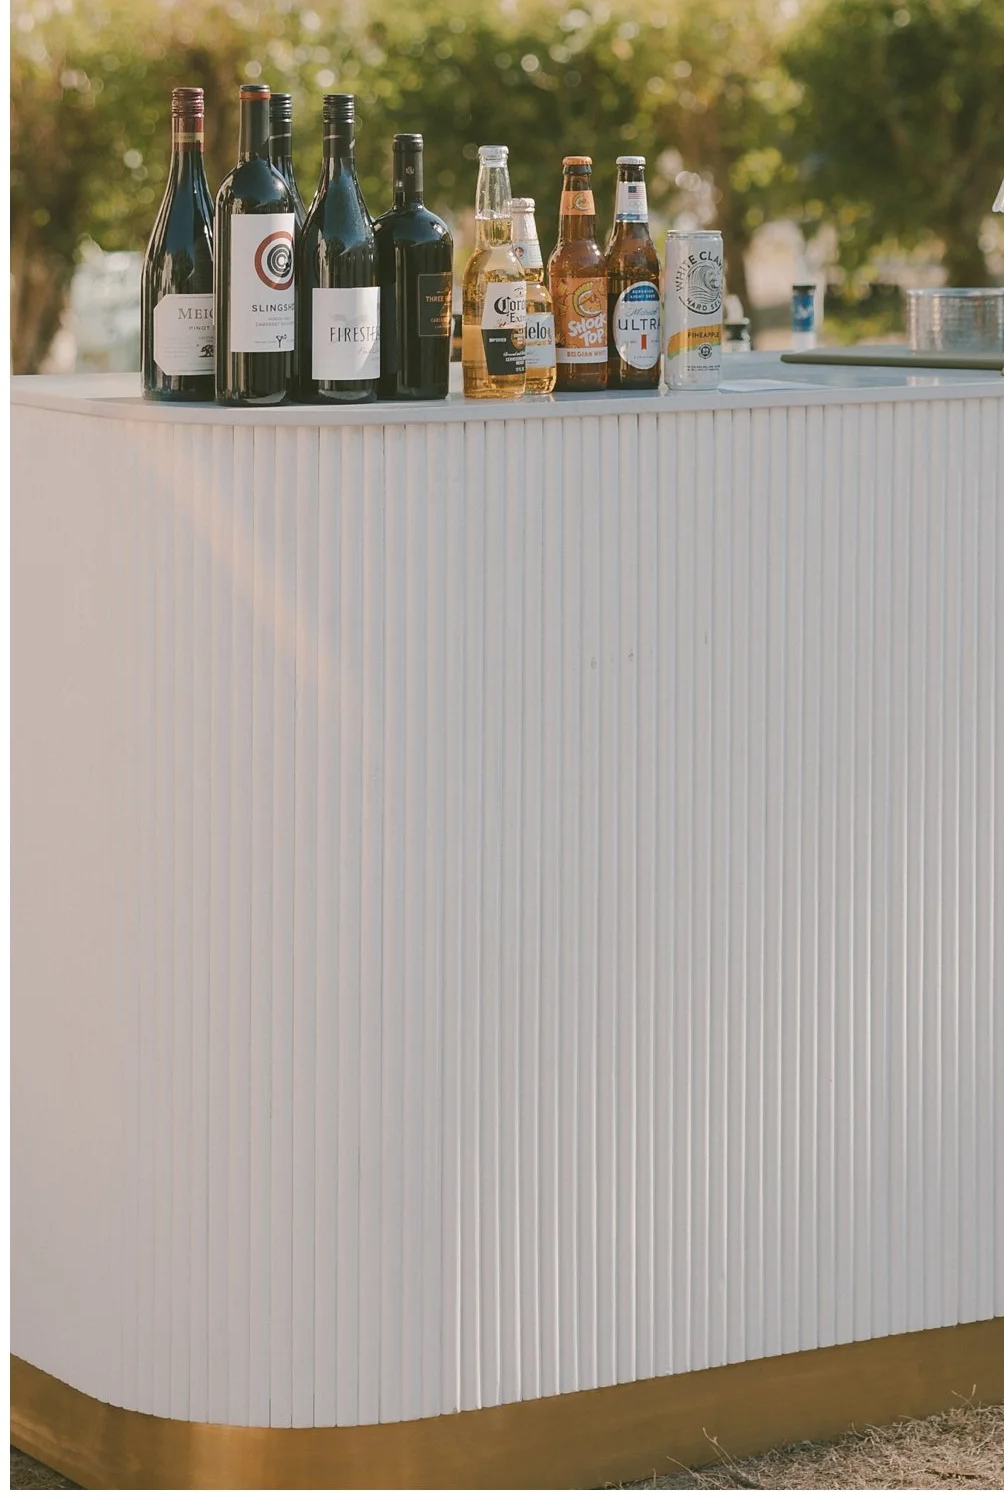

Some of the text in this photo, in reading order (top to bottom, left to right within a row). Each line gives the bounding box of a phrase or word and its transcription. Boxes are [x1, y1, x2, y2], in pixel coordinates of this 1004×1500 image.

[676, 255, 698, 292] WHITE
[686, 298, 708, 311] HARD
[568, 313, 607, 337] SHOCK
[580, 329, 604, 347] TOP
[687, 331, 720, 339] PINEAPPLE
